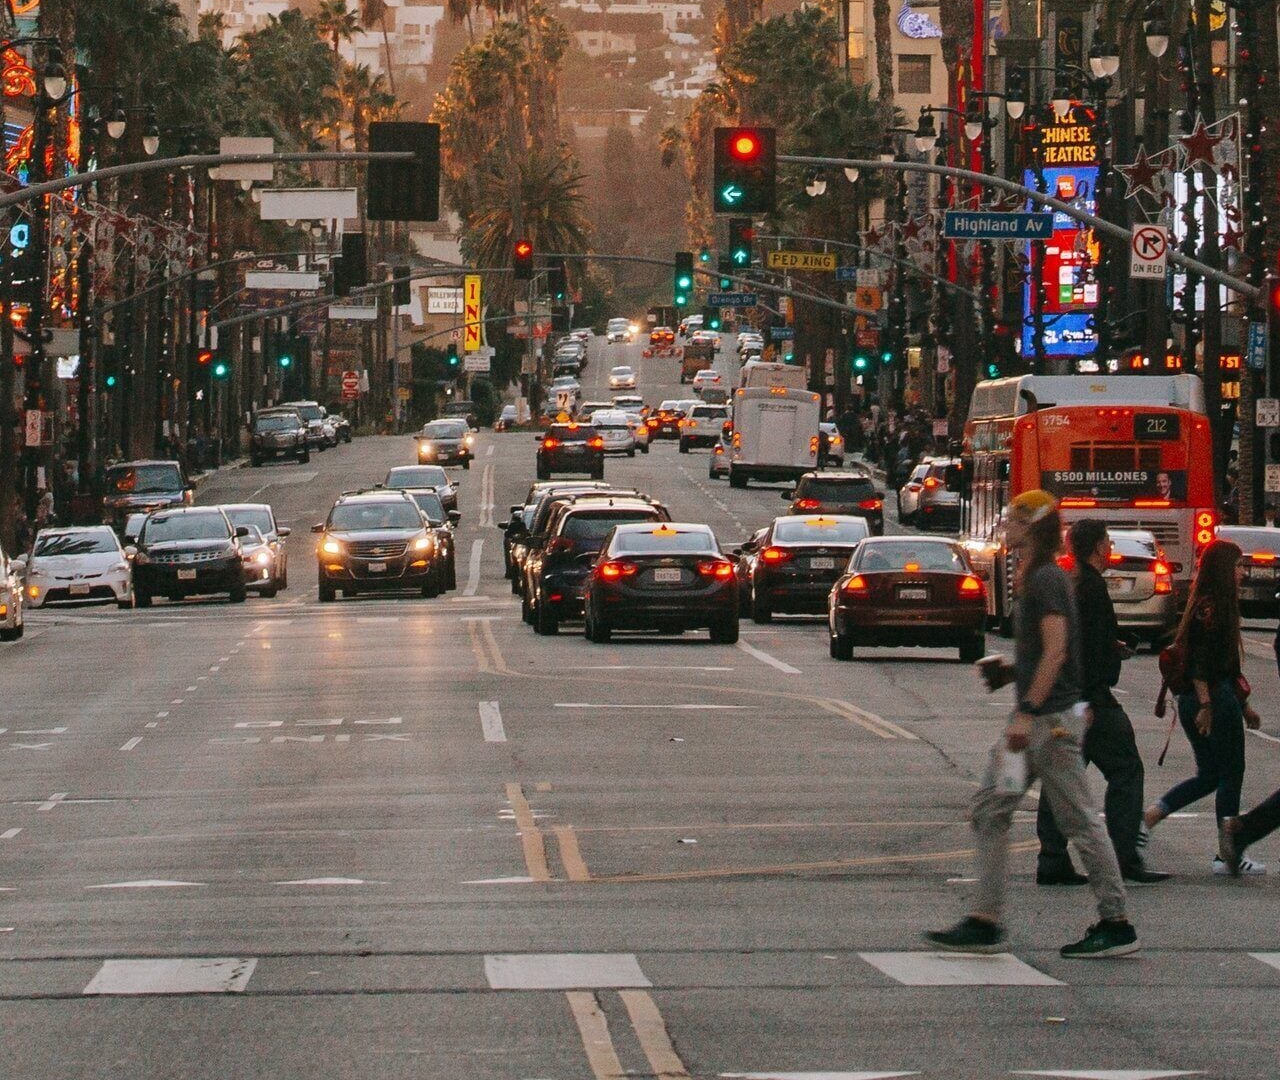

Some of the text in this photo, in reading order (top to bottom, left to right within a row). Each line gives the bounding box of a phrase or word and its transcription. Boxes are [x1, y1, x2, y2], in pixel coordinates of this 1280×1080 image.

[954, 218, 1044, 235] Highland Av
[773, 254, 832, 267] PED XING
[1133, 264, 1163, 274] ON RED
[466, 283, 479, 342] INN
[1147, 419, 1168, 432] 212
[1054, 471, 1148, 482] $500 MILLONES
